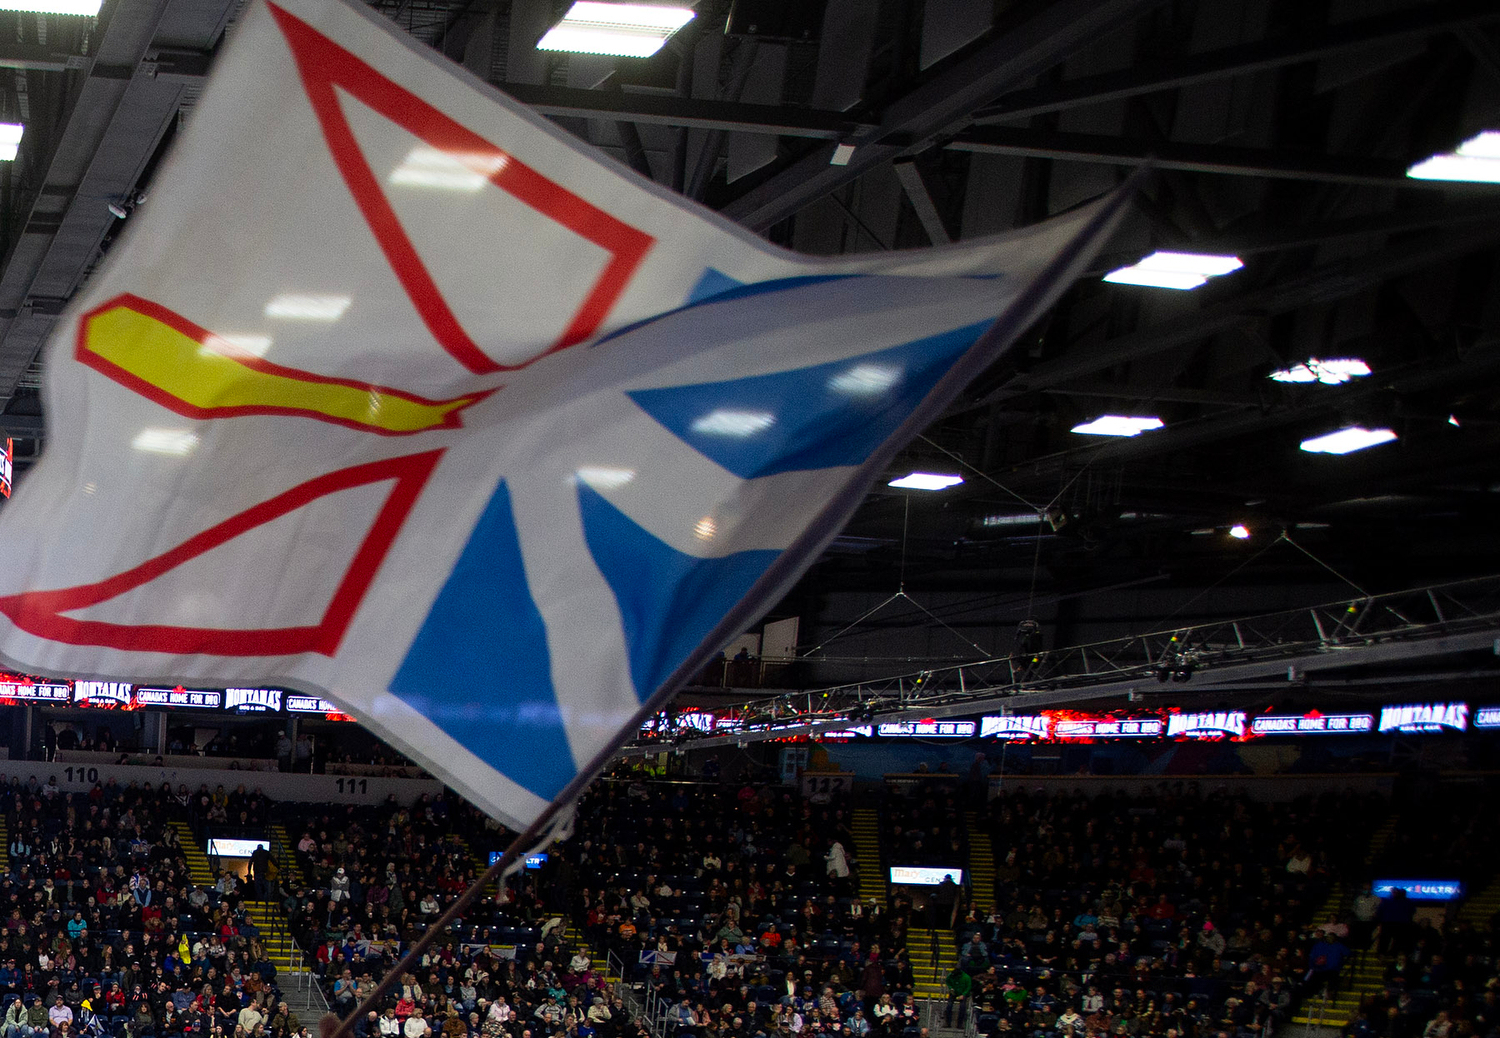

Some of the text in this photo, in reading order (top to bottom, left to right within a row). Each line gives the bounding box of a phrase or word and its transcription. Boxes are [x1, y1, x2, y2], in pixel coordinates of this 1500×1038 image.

[39, 686, 52, 697] FOR
[74, 681, 132, 704] MONTANA'S
[139, 690, 168, 702] CANADA'S
[170, 693, 187, 703] HOME
[191, 694, 203, 705] FOR
[225, 688, 283, 711] MONTANA'S
[289, 698, 316, 710] CANADA'S
[1167, 712, 1247, 737] MONTANA'S
[1254, 717, 1369, 731] CANADA'S HOME FOR BBQ
[1378, 702, 1468, 732] MONTANA'S
[940, 724, 955, 734] FOR
[1096, 723, 1119, 733] HOME
[1122, 723, 1138, 733] FOR
[64, 767, 98, 783] 110
[335, 778, 367, 794] 111
[808, 777, 845, 794] 112
